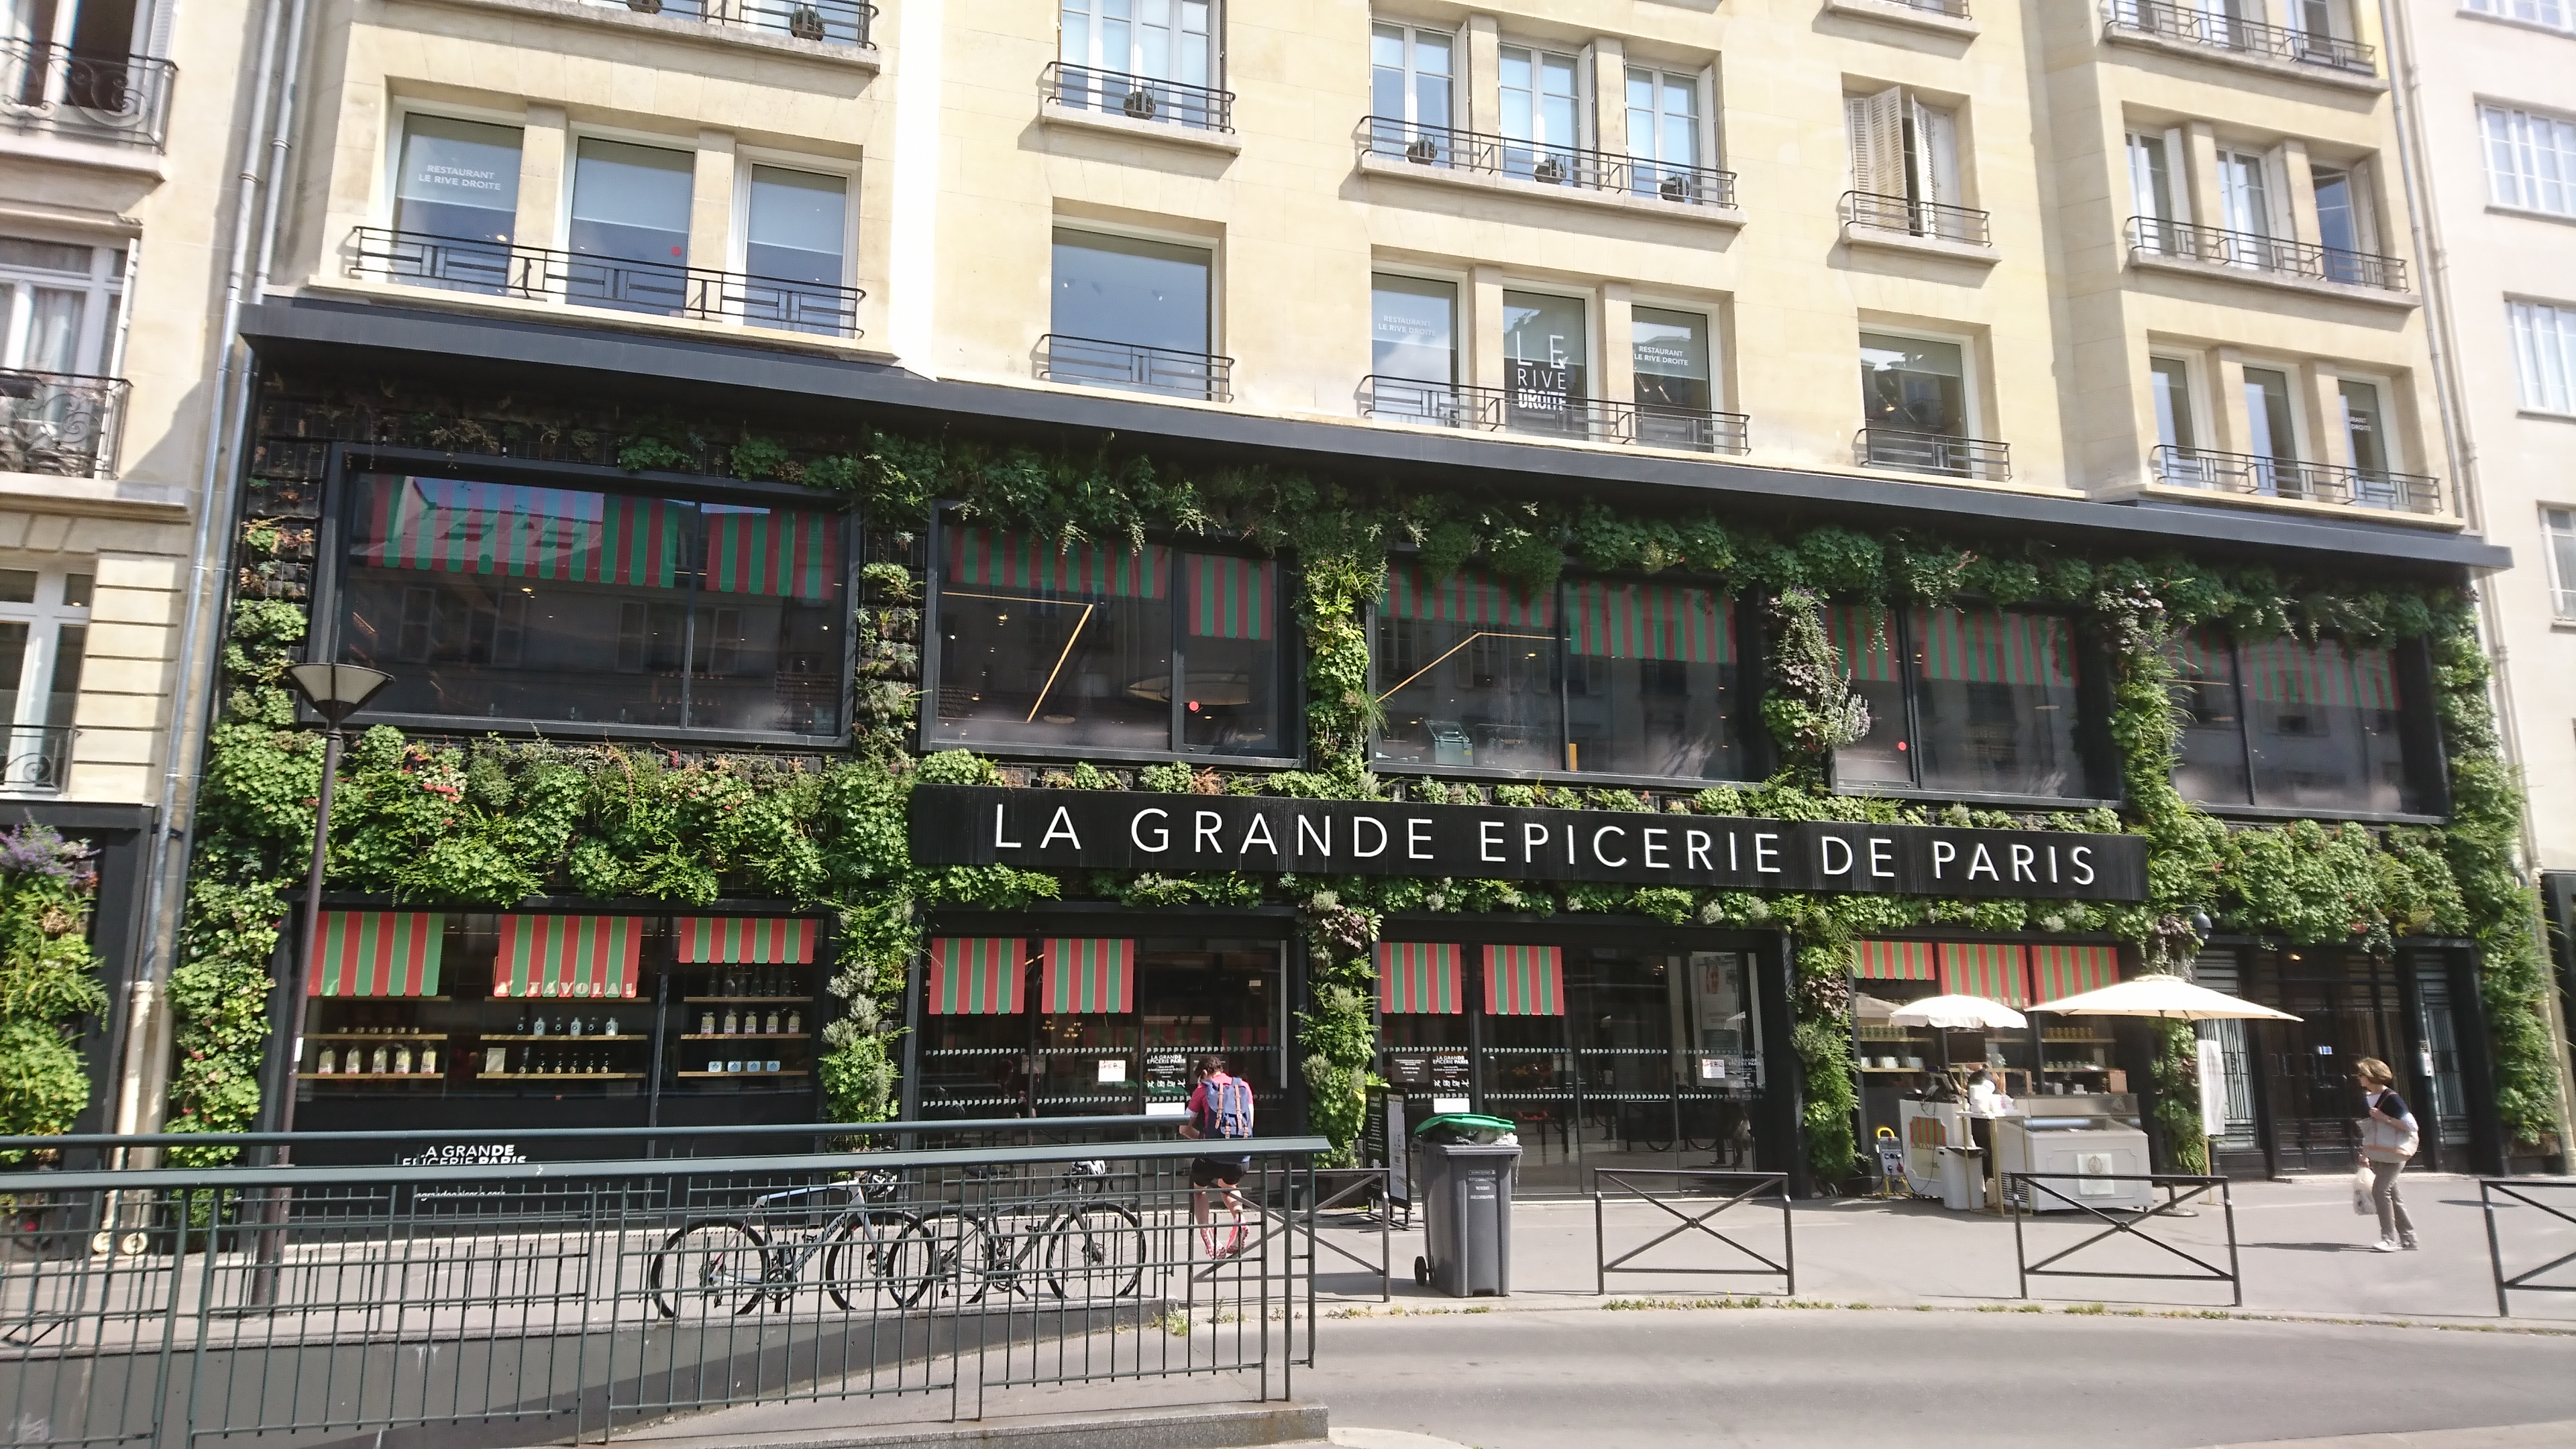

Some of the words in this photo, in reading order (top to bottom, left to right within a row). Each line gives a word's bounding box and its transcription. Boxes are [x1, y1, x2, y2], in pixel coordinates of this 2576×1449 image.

[427, 164, 494, 179] RESTAURANT
[419, 174, 431, 182] LE
[434, 175, 458, 185] RIVE
[462, 179, 501, 191] DROITE
[1383, 315, 1431, 327] RESTAURANT
[1389, 325, 1406, 333] RIVE
[1409, 327, 1436, 336] DROITE
[1517, 331, 1566, 369] LE
[1639, 345, 1683, 357] RESTAURANT
[1662, 357, 1688, 366] DROITE
[1517, 368, 1566, 389] RIVE
[1518, 388, 1566, 411] DROITE
[996, 803, 1081, 849] LA
[1131, 808, 1434, 859] GRANDE
[1480, 821, 1780, 873] EPICERIE
[1821, 836, 1894, 877] DE
[1933, 841, 2094, 885] PARIS
[529, 981, 633, 995] TAVOLA!
[441, 1144, 515, 1157] GRANDE
